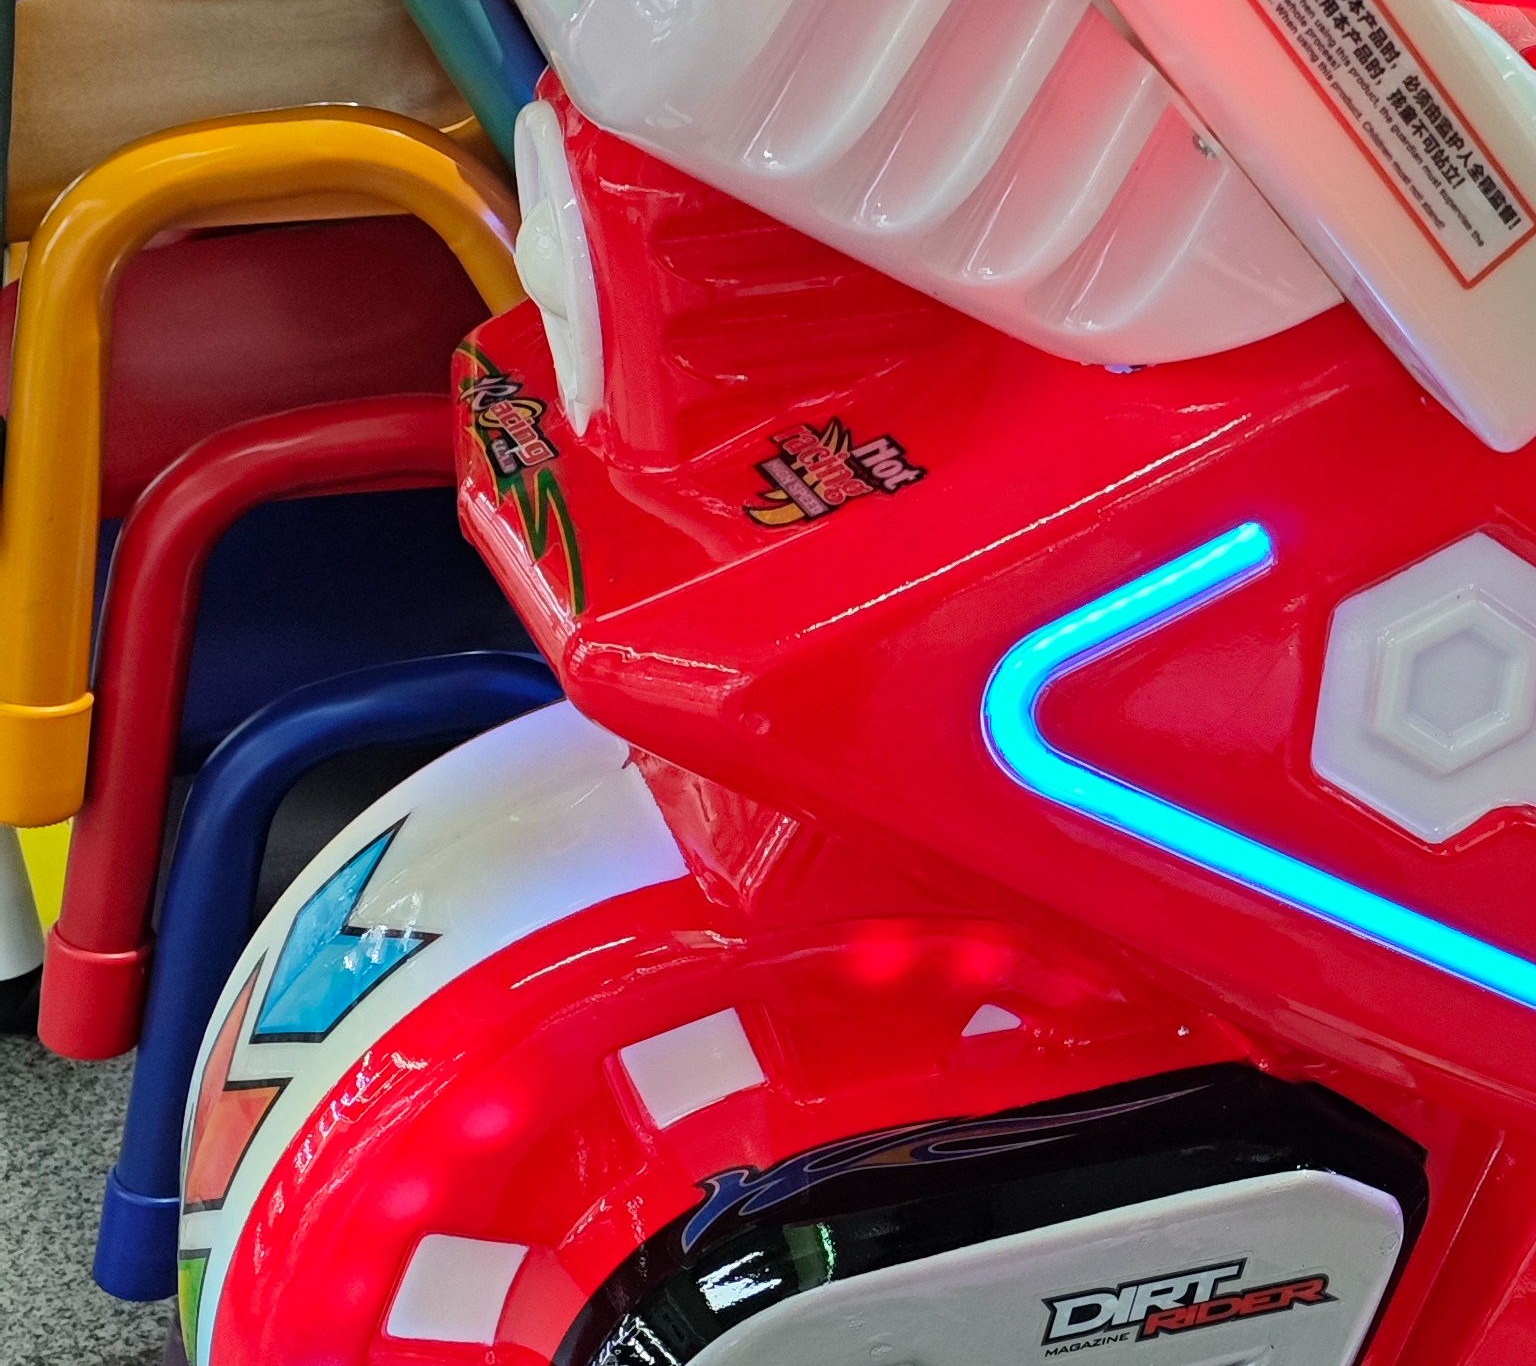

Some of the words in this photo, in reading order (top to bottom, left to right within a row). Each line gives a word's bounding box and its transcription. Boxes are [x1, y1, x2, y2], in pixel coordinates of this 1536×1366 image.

[1273, 2, 1300, 35] When
[1294, 32, 1321, 63] using
[1316, 60, 1335, 81] this
[1311, 17, 1338, 49] using
[1333, 46, 1352, 67] this
[1378, 105, 1394, 124] the
[1388, 122, 1425, 166] guardian
[1420, 163, 1442, 189] must
[1469, 229, 1485, 248] the
[772, 424, 875, 506] racing
[851, 437, 922, 491] Hot
[1048, 1263, 1240, 1341] DIRT
[1143, 1278, 1325, 1336] RIDER
[1044, 1331, 1131, 1358] MAGAZINE
